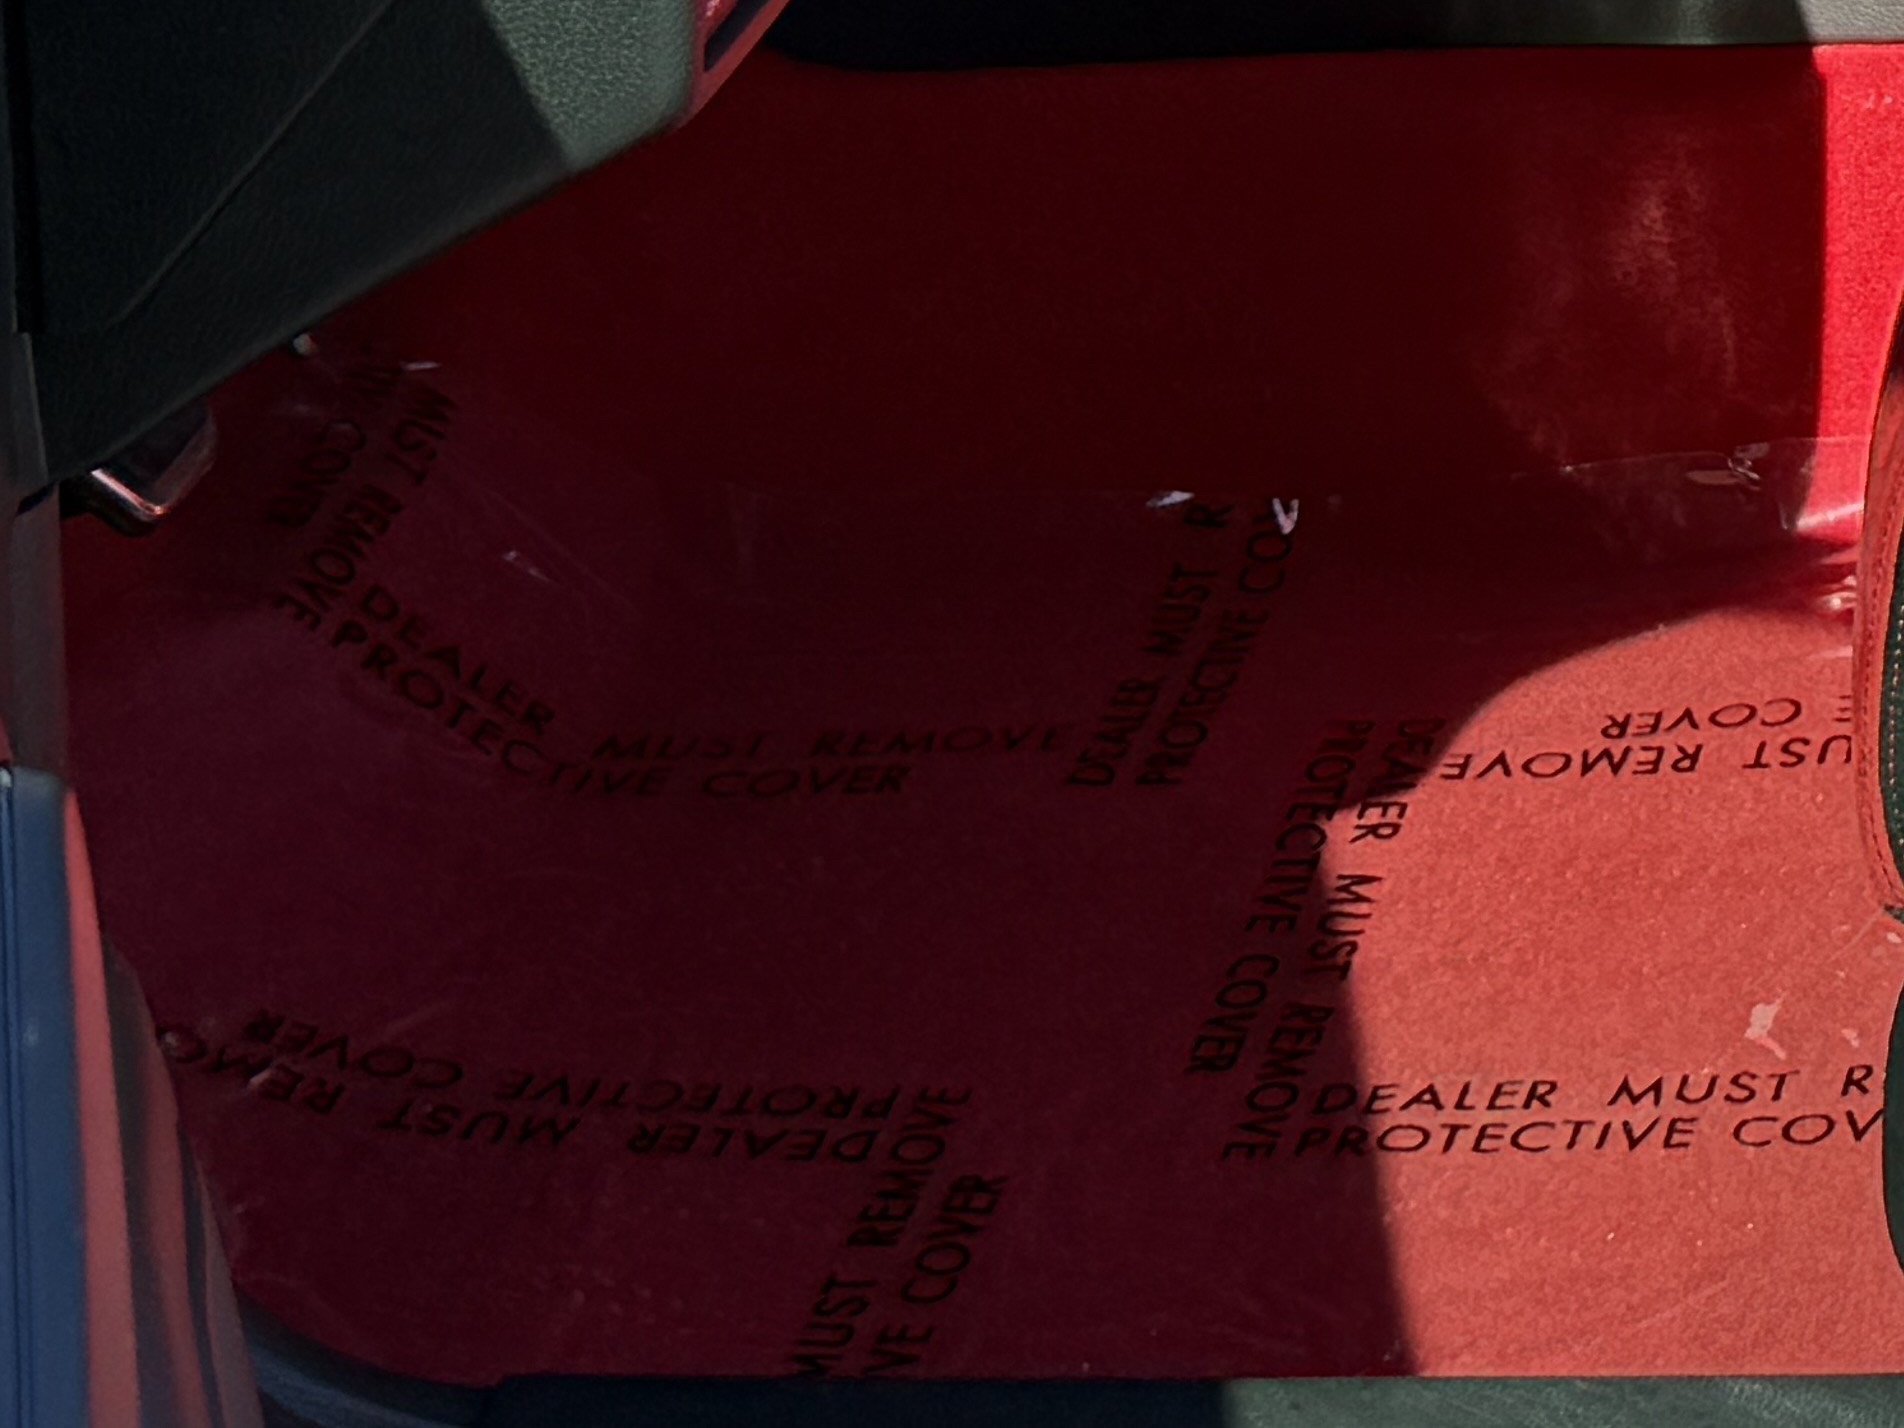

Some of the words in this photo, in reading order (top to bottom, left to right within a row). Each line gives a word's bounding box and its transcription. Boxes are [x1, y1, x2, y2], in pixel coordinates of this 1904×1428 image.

[1142, 562, 1219, 656] MUST
[360, 584, 555, 734] DEALER
[331, 620, 674, 797] PROTECTIVE
[701, 764, 911, 798] COVER
[1600, 697, 1802, 739] COVER
[1742, 735, 1853, 770] UST
[1350, 718, 1447, 843] DEALER
[1439, 742, 1704, 780] REMOVE
[1245, 720, 1375, 932] PROTECTIVE
[1302, 874, 1383, 981] MUST
[242, 1009, 462, 1089] COVER
[1184, 954, 1280, 1074] COVER
[156, 1020, 345, 1113] REMO
[494, 1069, 901, 1120] PROTECTIVE
[1221, 1001, 1334, 1160] REMOVE
[1310, 1080, 1559, 1116] DEALER
[1606, 1070, 1801, 1107] MUST
[376, 1097, 582, 1145] MUST
[627, 1123, 880, 1162] DEALER
[838, 1085, 973, 1247] REMOVE
[1295, 1116, 1700, 1156] PROTECTIVE
[1732, 1109, 1884, 1147] COV
[900, 1175, 1009, 1304] COVER
